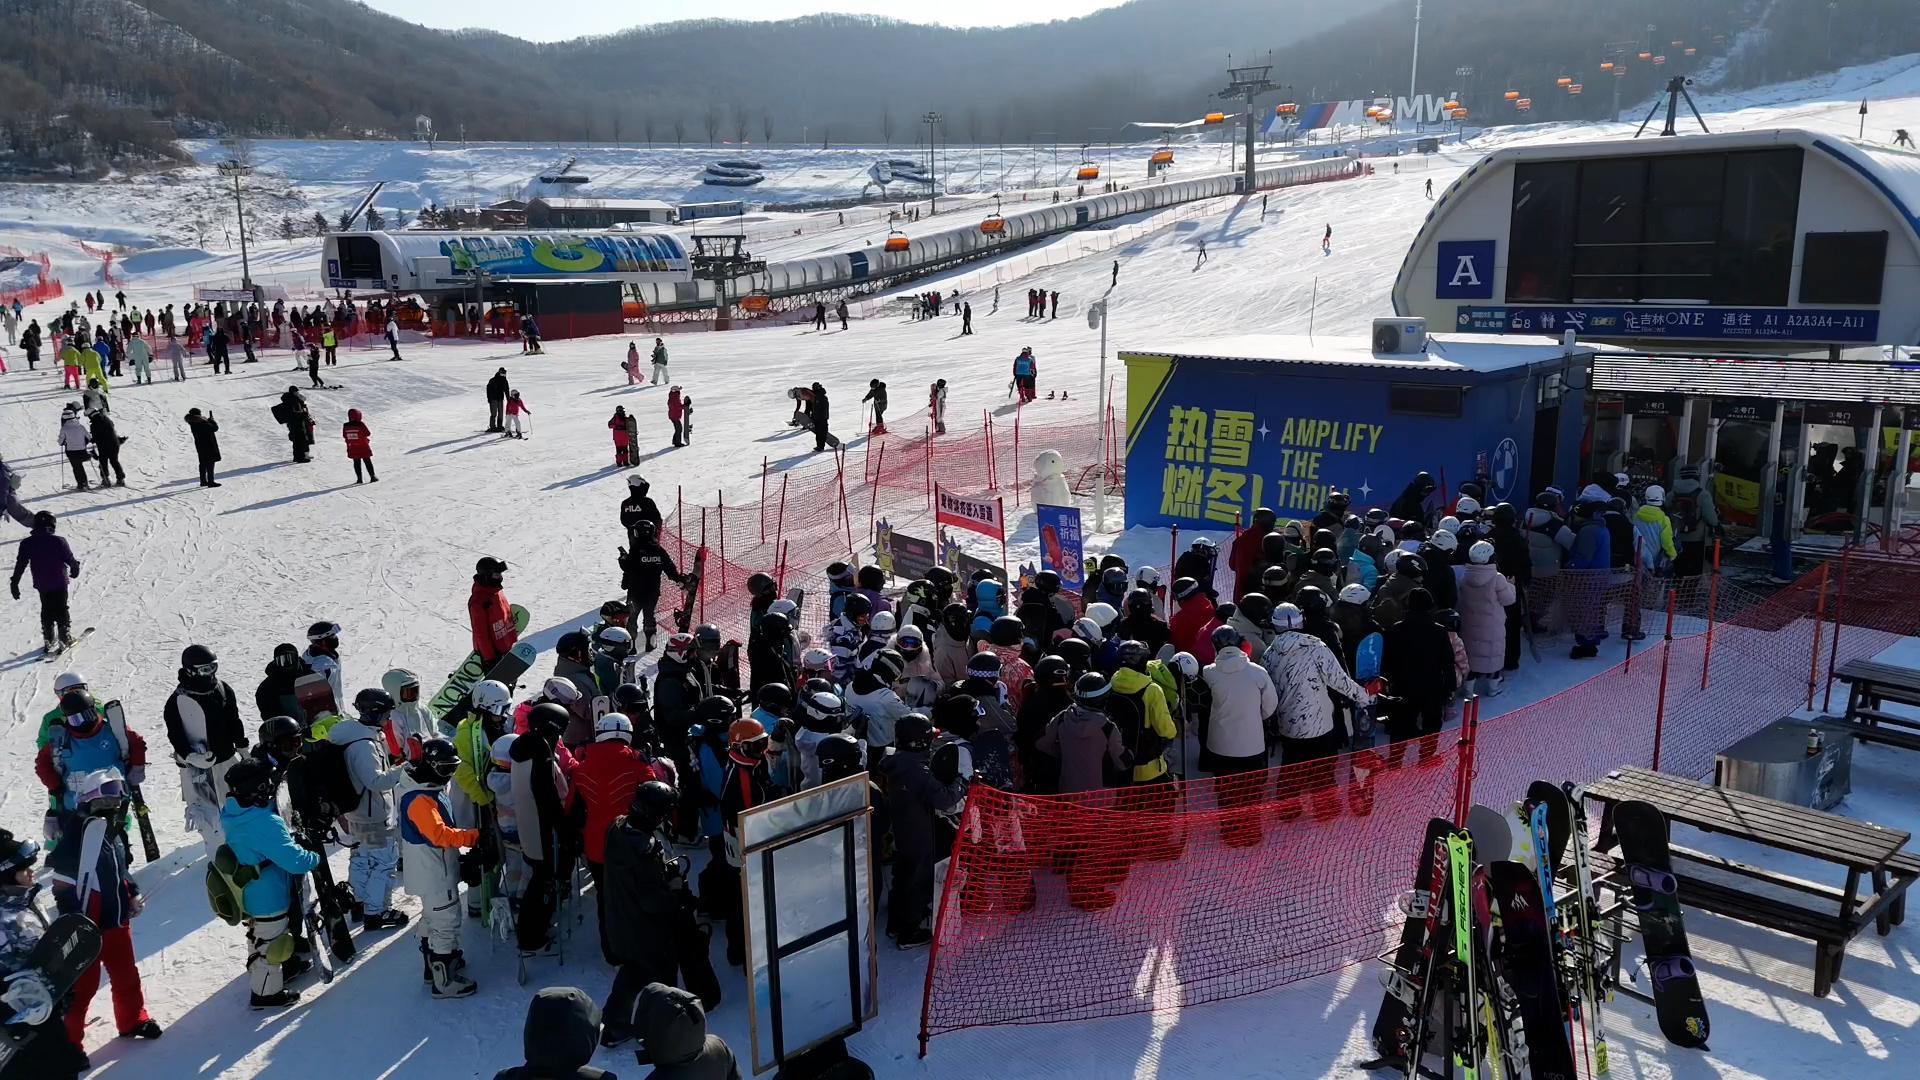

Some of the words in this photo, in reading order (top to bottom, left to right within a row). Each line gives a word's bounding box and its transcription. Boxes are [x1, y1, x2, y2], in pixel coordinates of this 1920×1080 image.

[1448, 255, 1481, 286] A
[1523, 318, 1531, 329] 8
[1721, 312, 1751, 327] 通往
[1763, 315, 1778, 326] A1
[1165, 405, 1254, 467] 热雪
[1280, 416, 1384, 454] AMPLIFY
[1280, 448, 1323, 481] THE
[1058, 514, 1078, 529] 雪山
[1058, 528, 1080, 541] 祈福
[1457, 862, 1467, 932] FISCHER
